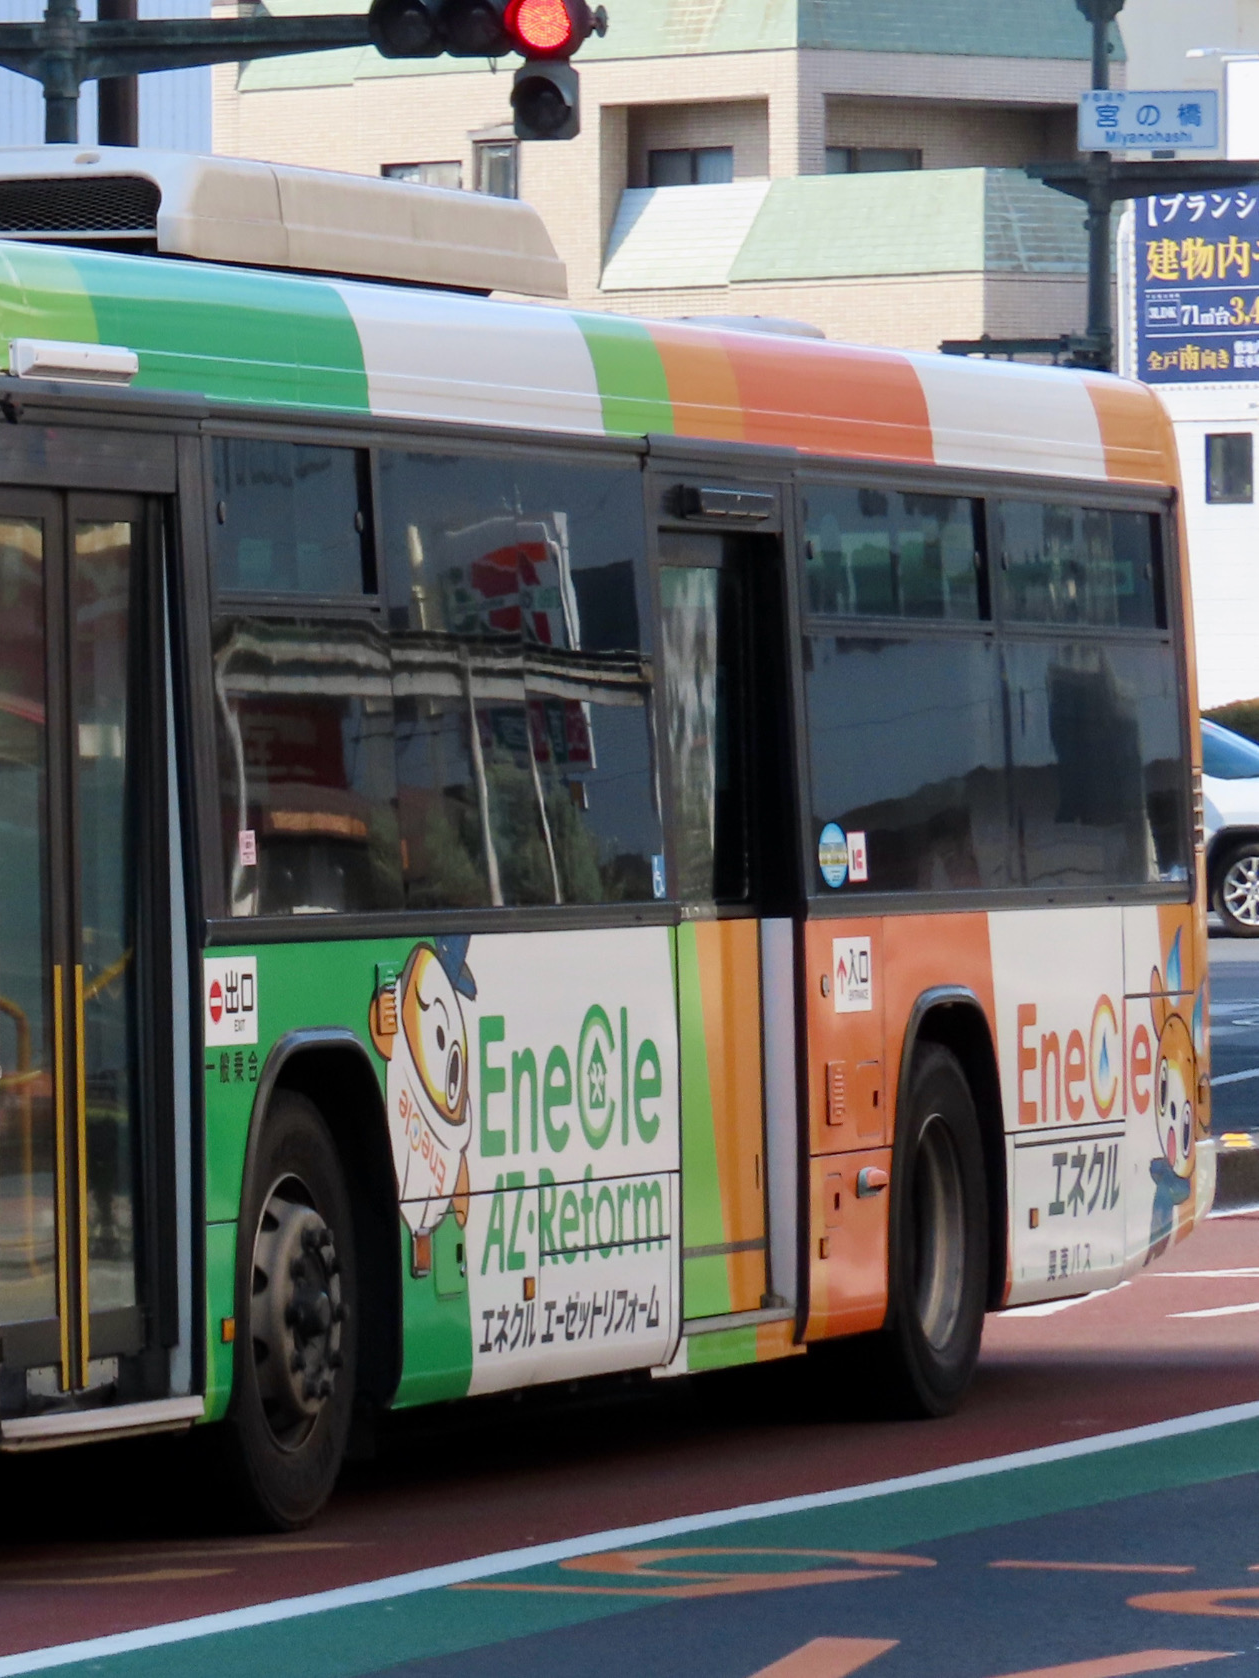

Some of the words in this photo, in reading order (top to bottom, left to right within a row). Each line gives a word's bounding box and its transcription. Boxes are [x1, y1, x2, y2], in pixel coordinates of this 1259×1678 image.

[1095, 103, 1202, 128] 宮の橋
[1105, 131, 1193, 146] Miyanohashi
[1145, 235, 1259, 281] 建物内
[1146, 344, 1230, 372] 全戸南向き
[848, 948, 869, 986] 入口
[225, 969, 254, 1014] 出口
[1048, 1143, 1121, 1218] エネクル
[479, 1301, 537, 1354] エネクル
